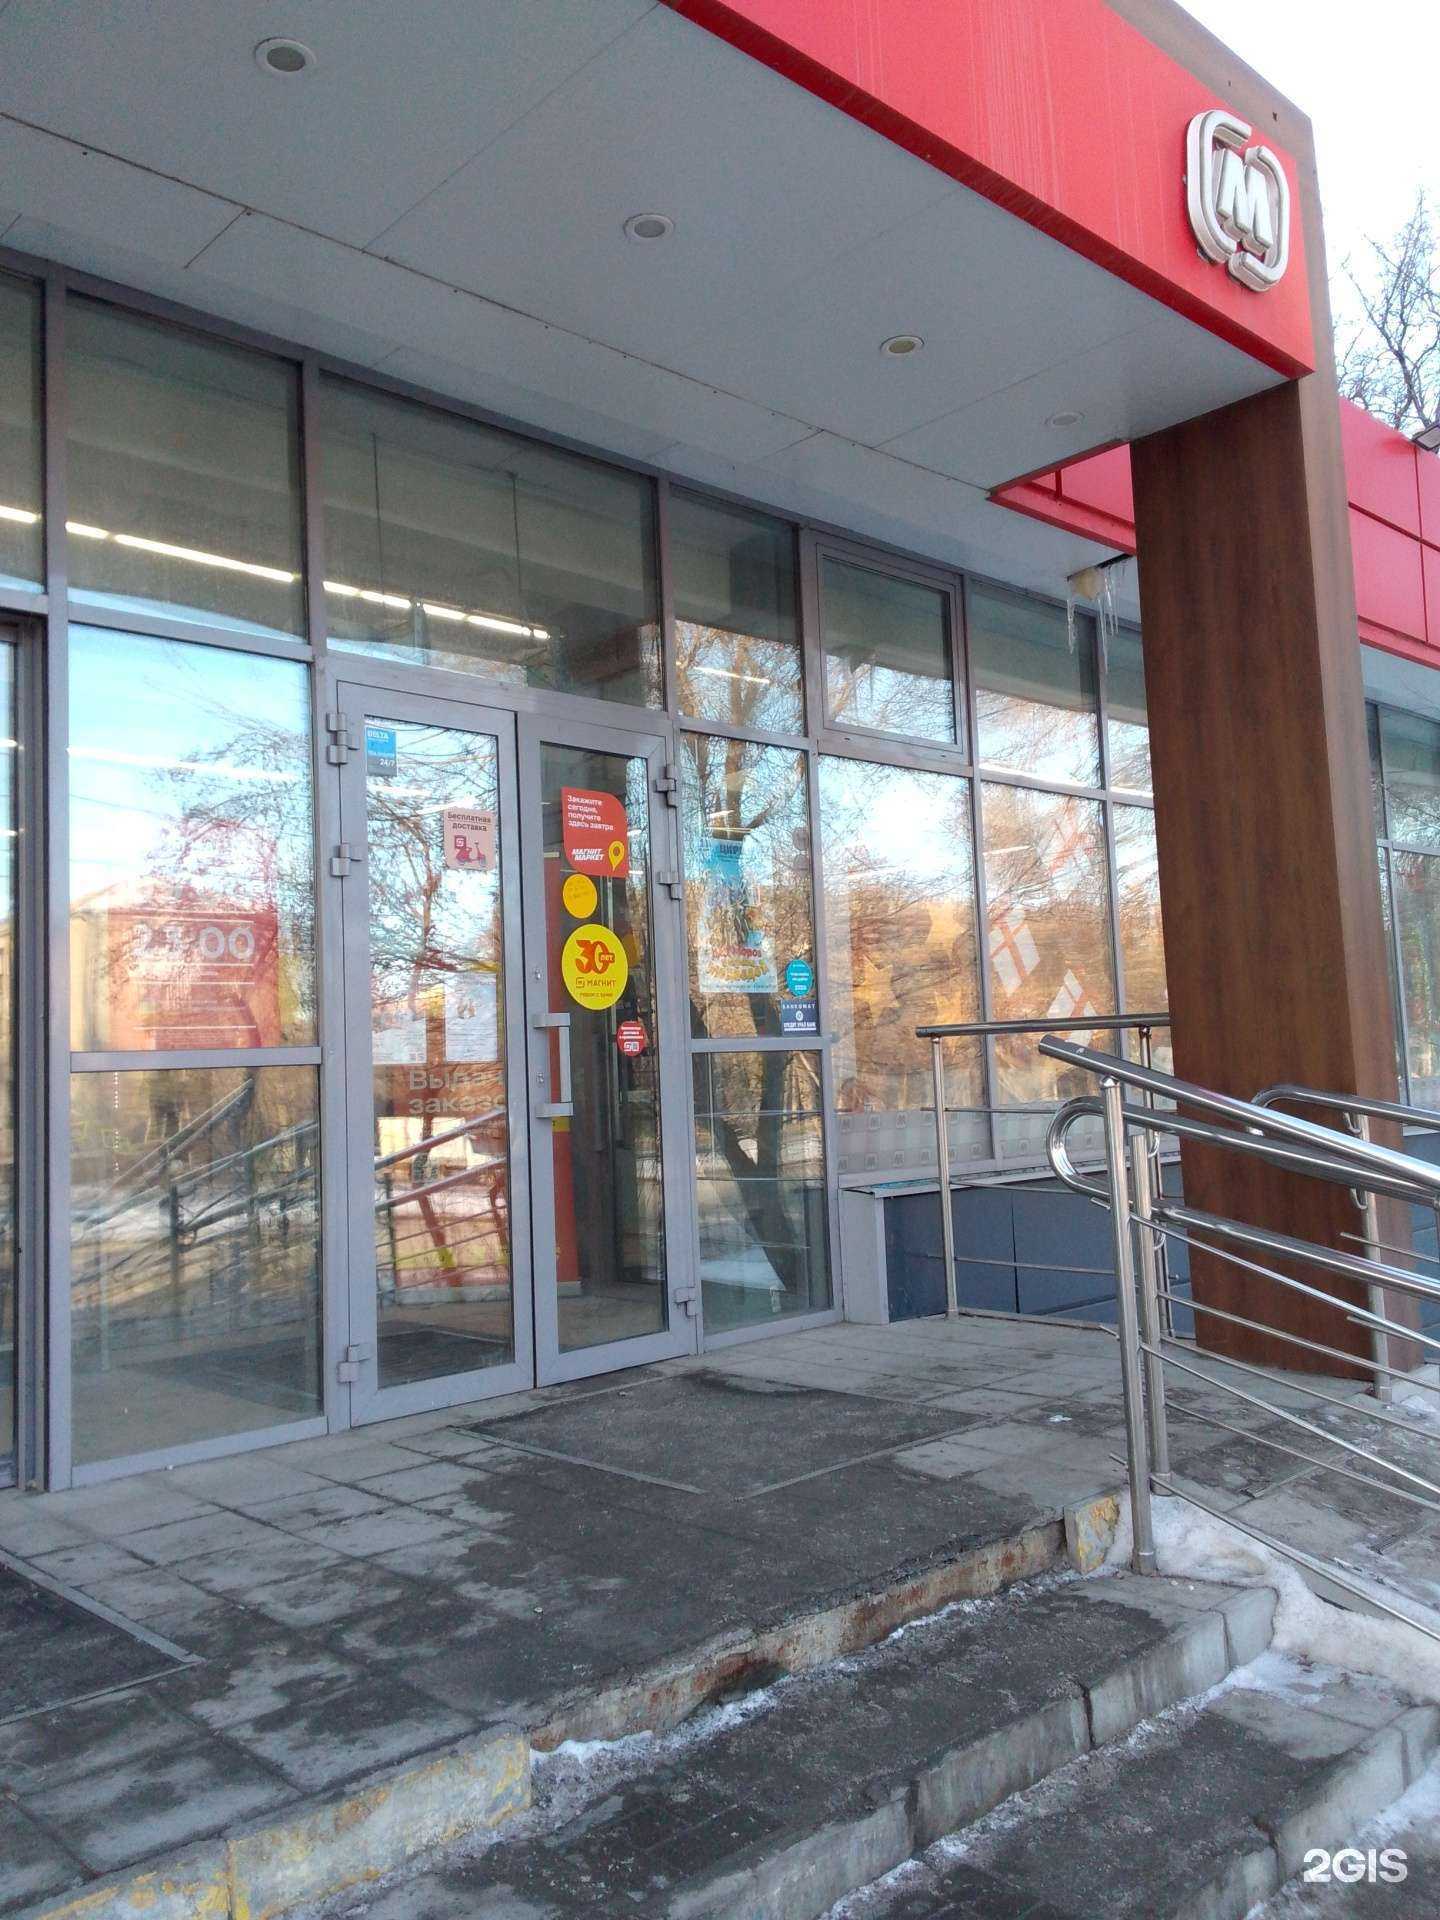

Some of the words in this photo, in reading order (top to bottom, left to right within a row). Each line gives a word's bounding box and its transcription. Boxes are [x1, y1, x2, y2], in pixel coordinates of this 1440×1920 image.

[567, 795, 603, 806] Закажите
[447, 811, 492, 823] Бесплатная
[567, 812, 602, 821] получите
[452, 822, 488, 832] доставка
[571, 848, 603, 856] МАГНИТ
[574, 854, 605, 862] МАРКЕТ
[575, 939, 609, 974] 30
[587, 980, 616, 988] МАГНИТ
